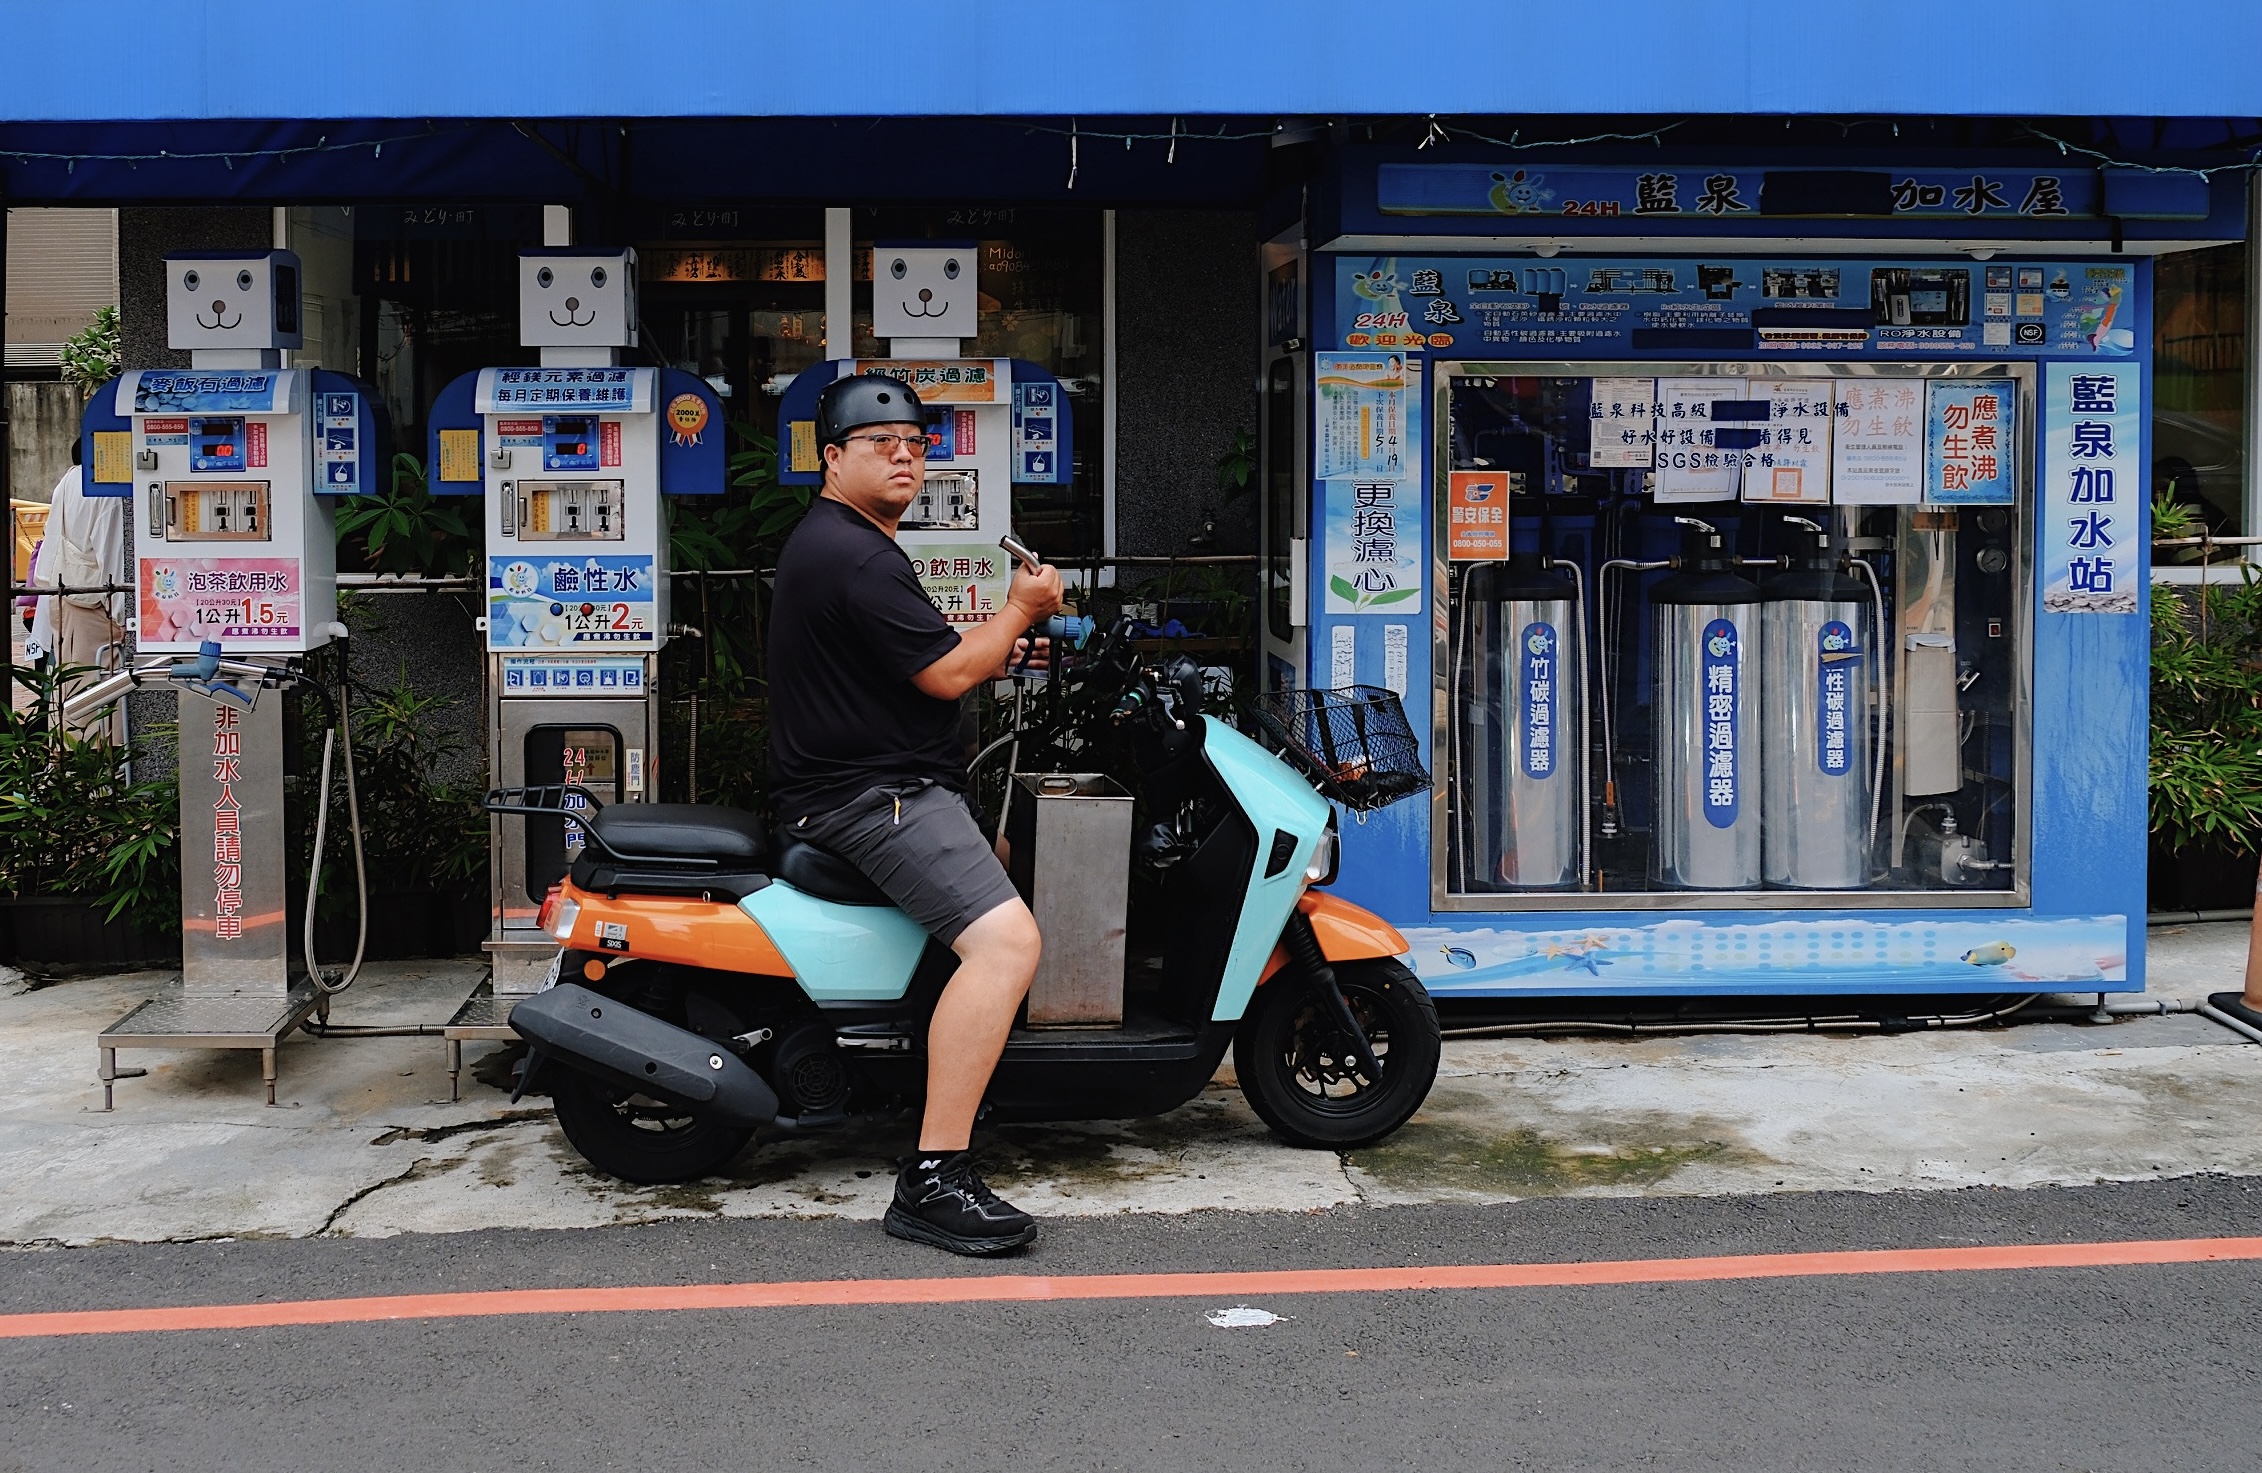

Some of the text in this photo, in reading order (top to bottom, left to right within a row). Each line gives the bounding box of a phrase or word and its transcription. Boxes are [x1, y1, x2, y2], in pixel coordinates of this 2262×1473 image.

[1634, 173, 2070, 217] 藍泉 加水屋
[1561, 200, 1621, 217] 24H
[1409, 269, 1464, 325] 藍泉
[1353, 312, 1408, 329] 24H
[1348, 332, 1453, 347] 歡迎光臨
[1879, 329, 1962, 339] RO淨水設備
[2023, 328, 2039, 337] NSF
[151, 376, 268, 393] 麥飯石過濾
[501, 371, 627, 384] 經鎂元素過濾
[498, 387, 627, 402] 每月定期保養維護
[1845, 387, 1916, 412] 應煮沸
[1590, 400, 1850, 420] 藍泉科技高級 淨水設備
[1621, 427, 1813, 446] 好水好設備 看得見
[1841, 415, 1915, 438] 勿生飲
[1970, 394, 1998, 481] 應煮沸
[1942, 403, 1970, 491] 勿生飲
[1656, 451, 1776, 470] SGS檢驗合格
[2067, 372, 2119, 596] 藍泉加水站
[1452, 506, 1503, 524] 警安保全
[1351, 478, 1398, 593] 更換濾心
[1452, 539, 1503, 548] 0800-050-055
[912, 557, 994, 577] O飲用水
[188, 571, 288, 592] 泡茶飲用水
[553, 566, 638, 593] 鹼性水
[565, 603, 644, 631] 1公升2元
[1528, 656, 1551, 773] 竹碳過濾器
[1825, 667, 1845, 770] 性碳過濾器
[1707, 664, 1734, 807] 精密過濾器
[630, 752, 640, 786] 防塵門
[213, 704, 243, 940] 非加水人員請勿停車
